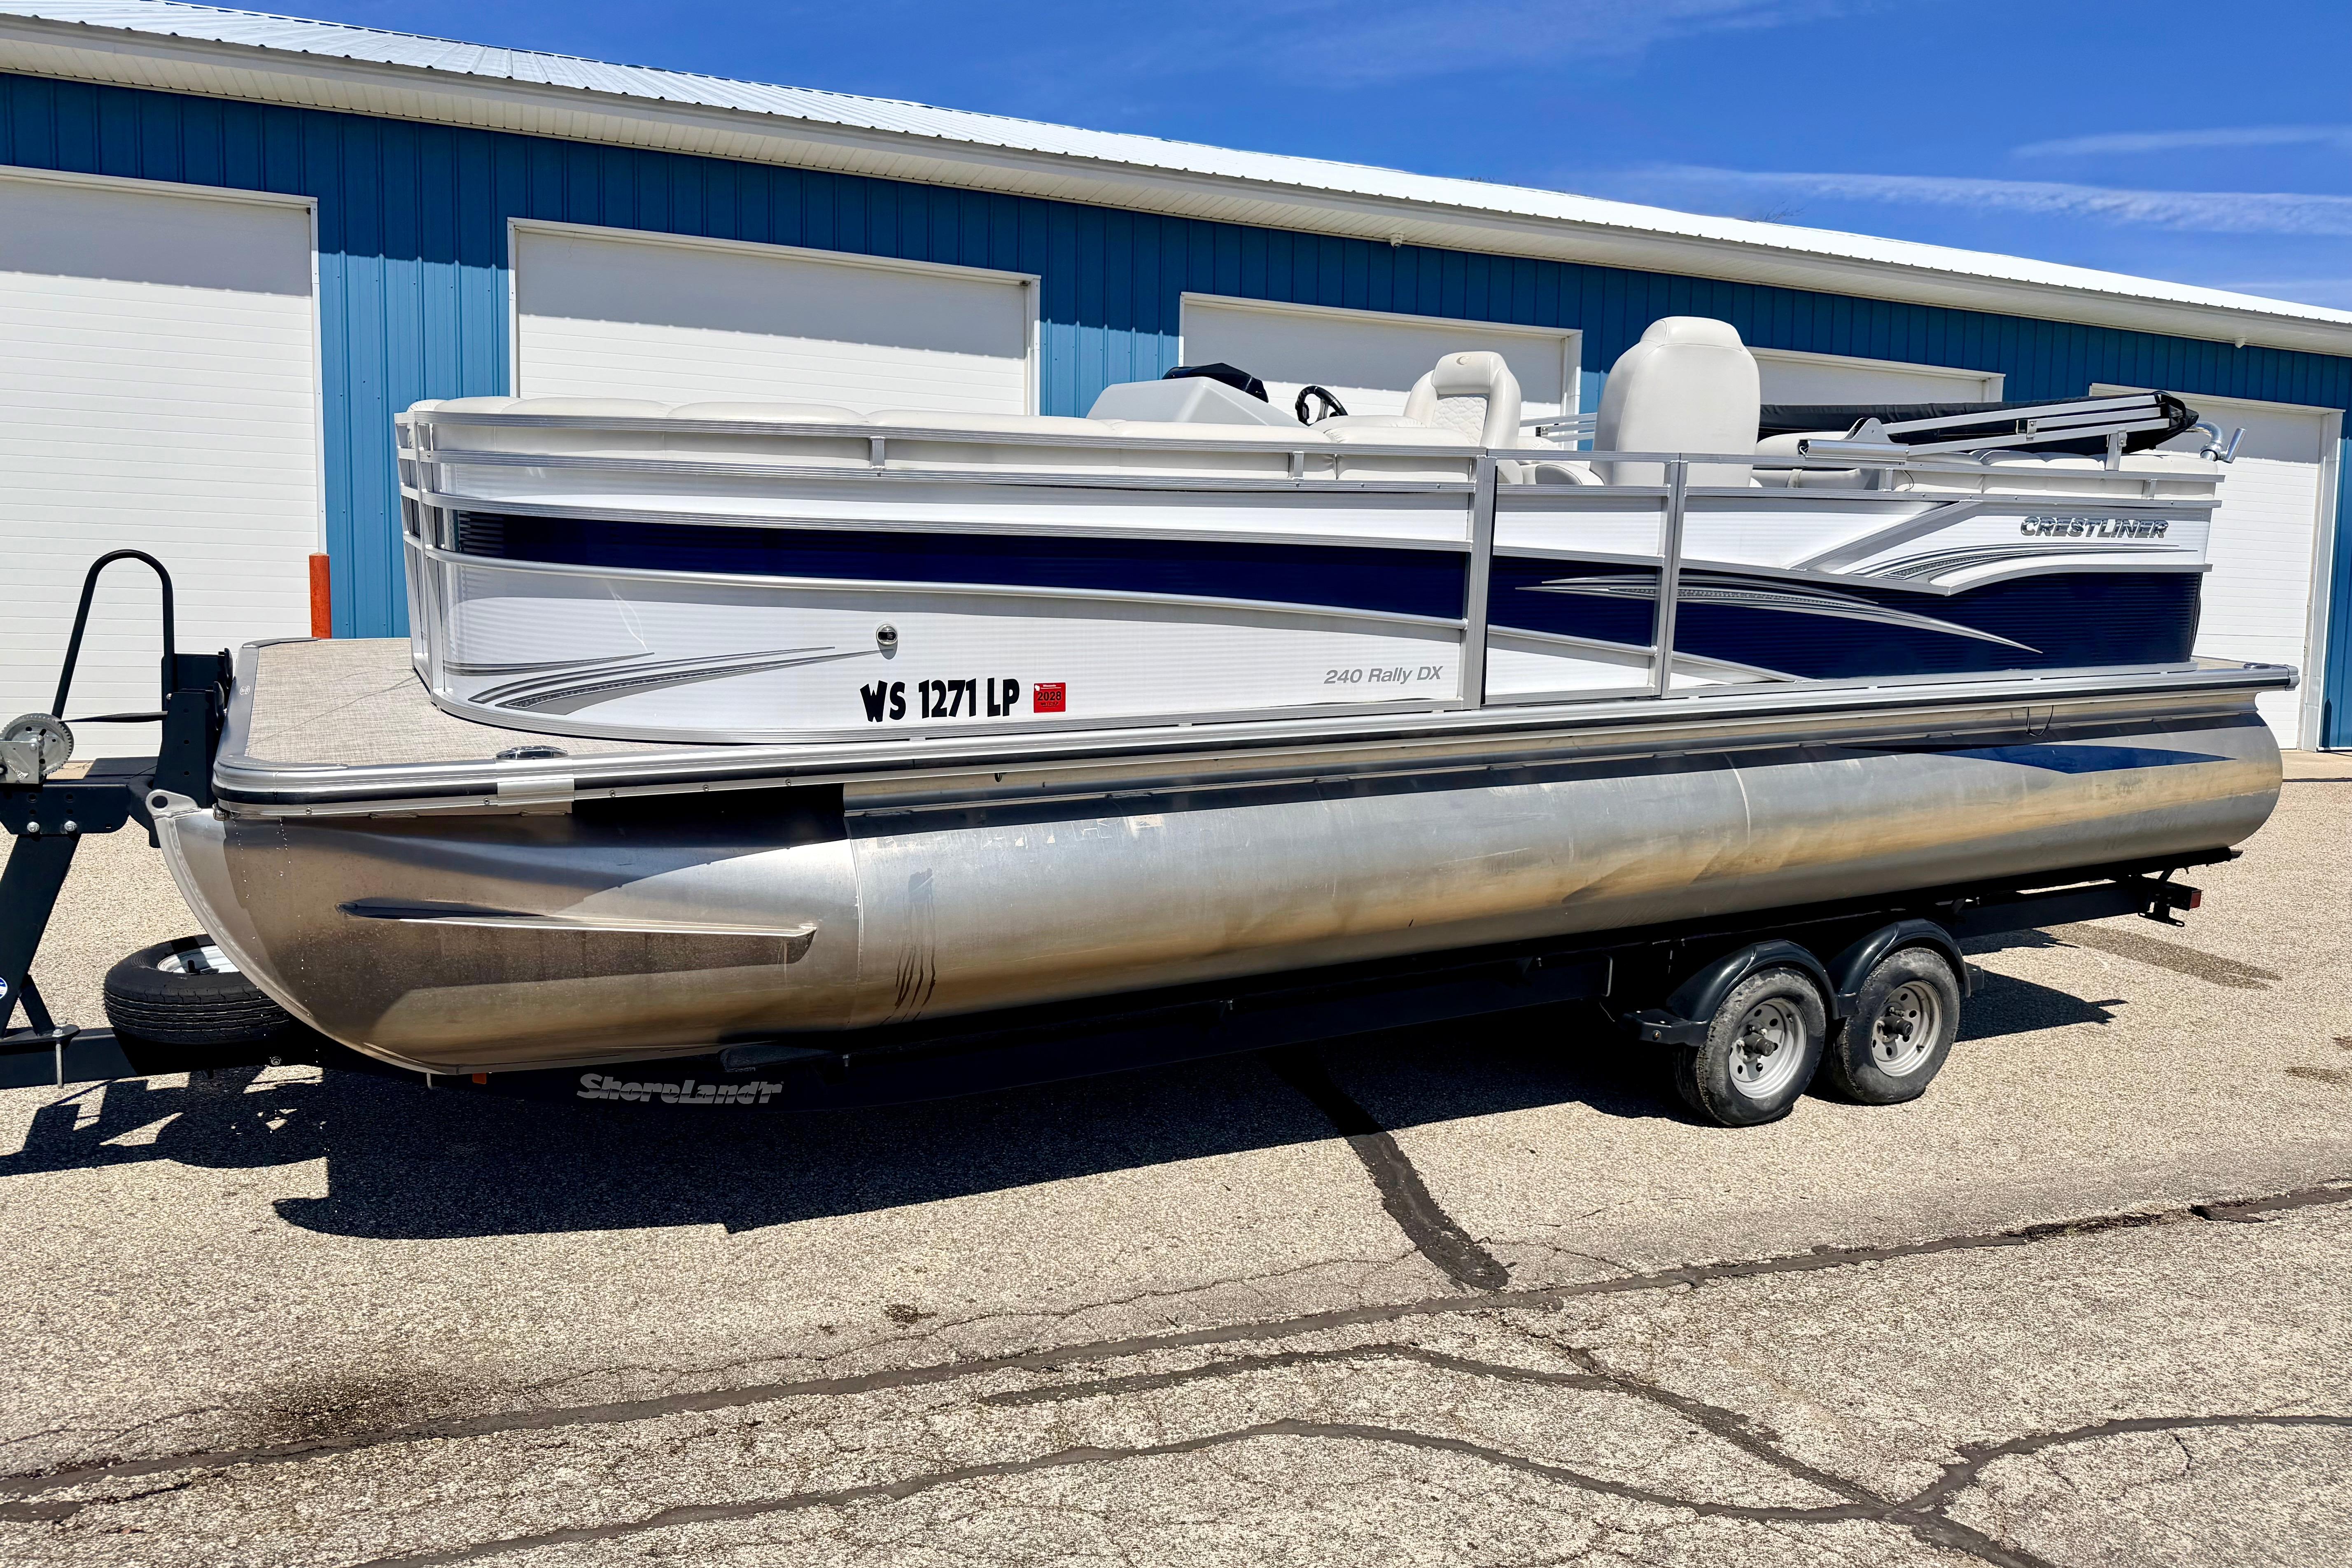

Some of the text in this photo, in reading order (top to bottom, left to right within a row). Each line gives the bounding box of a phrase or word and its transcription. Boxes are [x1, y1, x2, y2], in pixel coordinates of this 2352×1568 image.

[2021, 516, 2169, 539] CRESTLINER
[1324, 665, 1443, 684] 240 Rally DX
[860, 677, 1020, 722] WS 1271 LP
[1037, 691, 1062, 701] 2028
